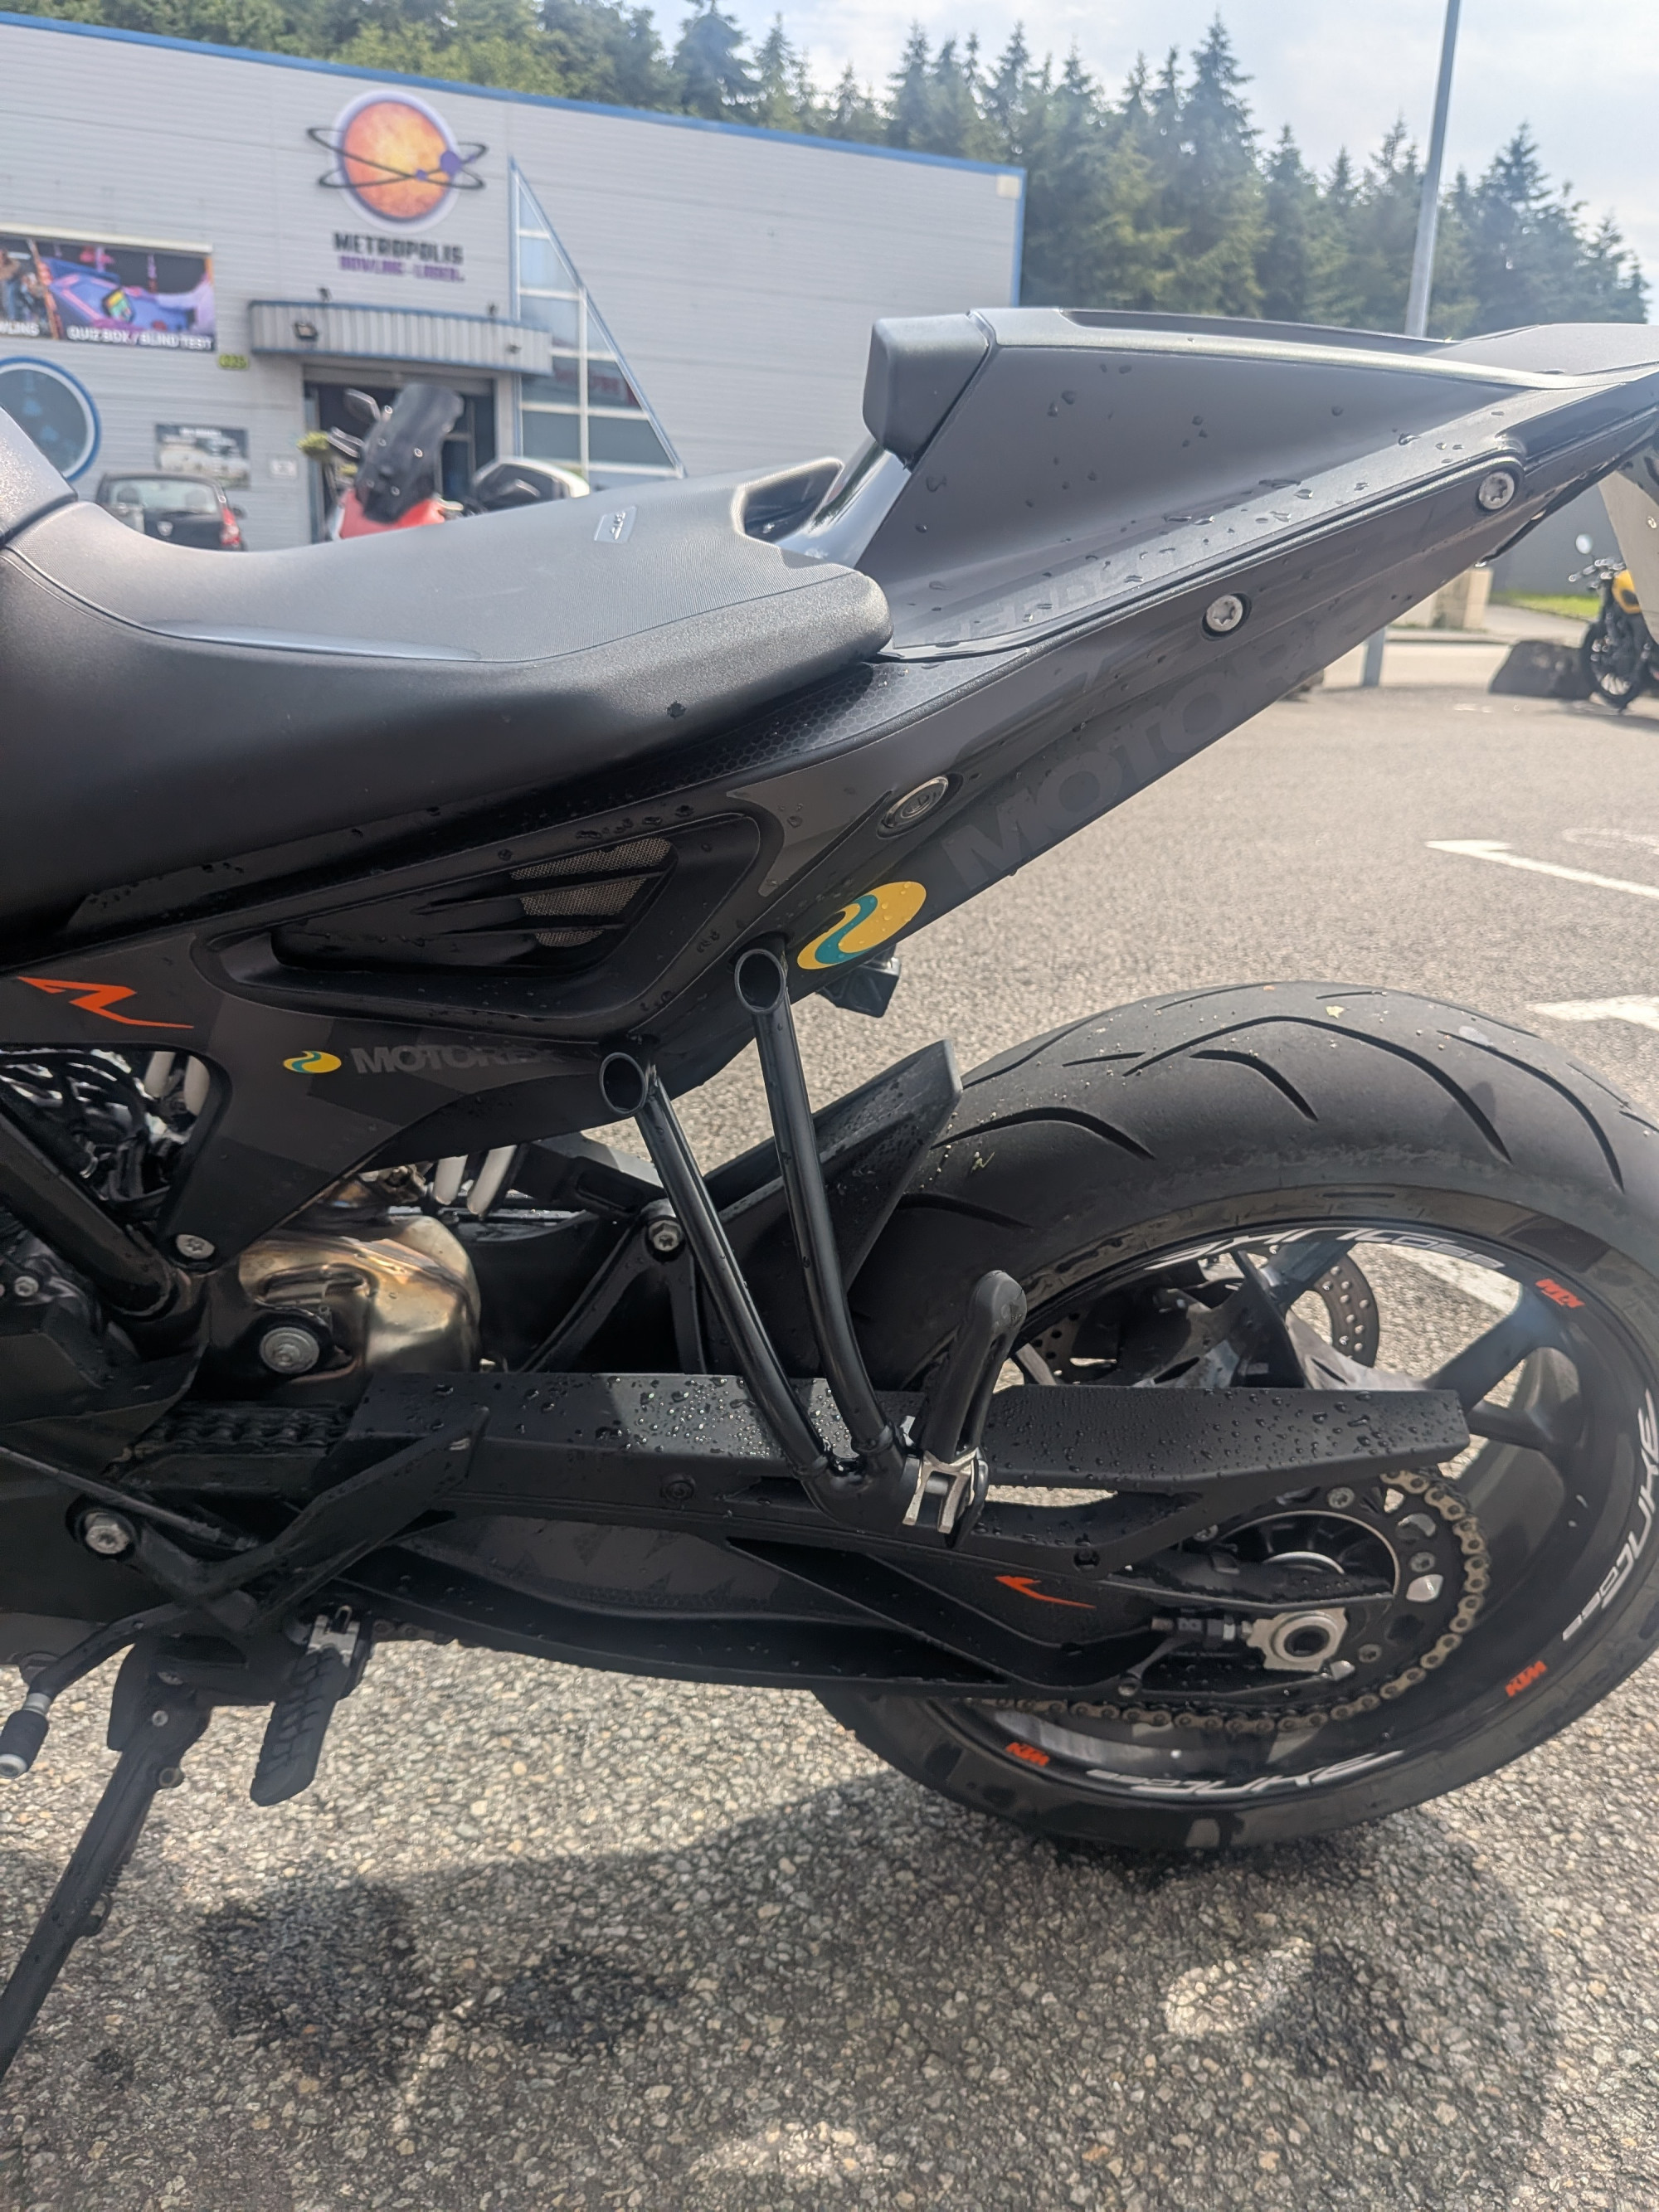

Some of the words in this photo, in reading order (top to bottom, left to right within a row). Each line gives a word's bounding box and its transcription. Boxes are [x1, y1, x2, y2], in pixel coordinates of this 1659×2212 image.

[334, 232, 464, 264] METROPOLIS
[66, 325, 102, 341] QUIZ
[139, 332, 179, 348] BLIND
[180, 333, 212, 349] TEST
[1505, 1660, 1548, 1698] KTM
[1005, 1742, 1050, 1767] KTM
